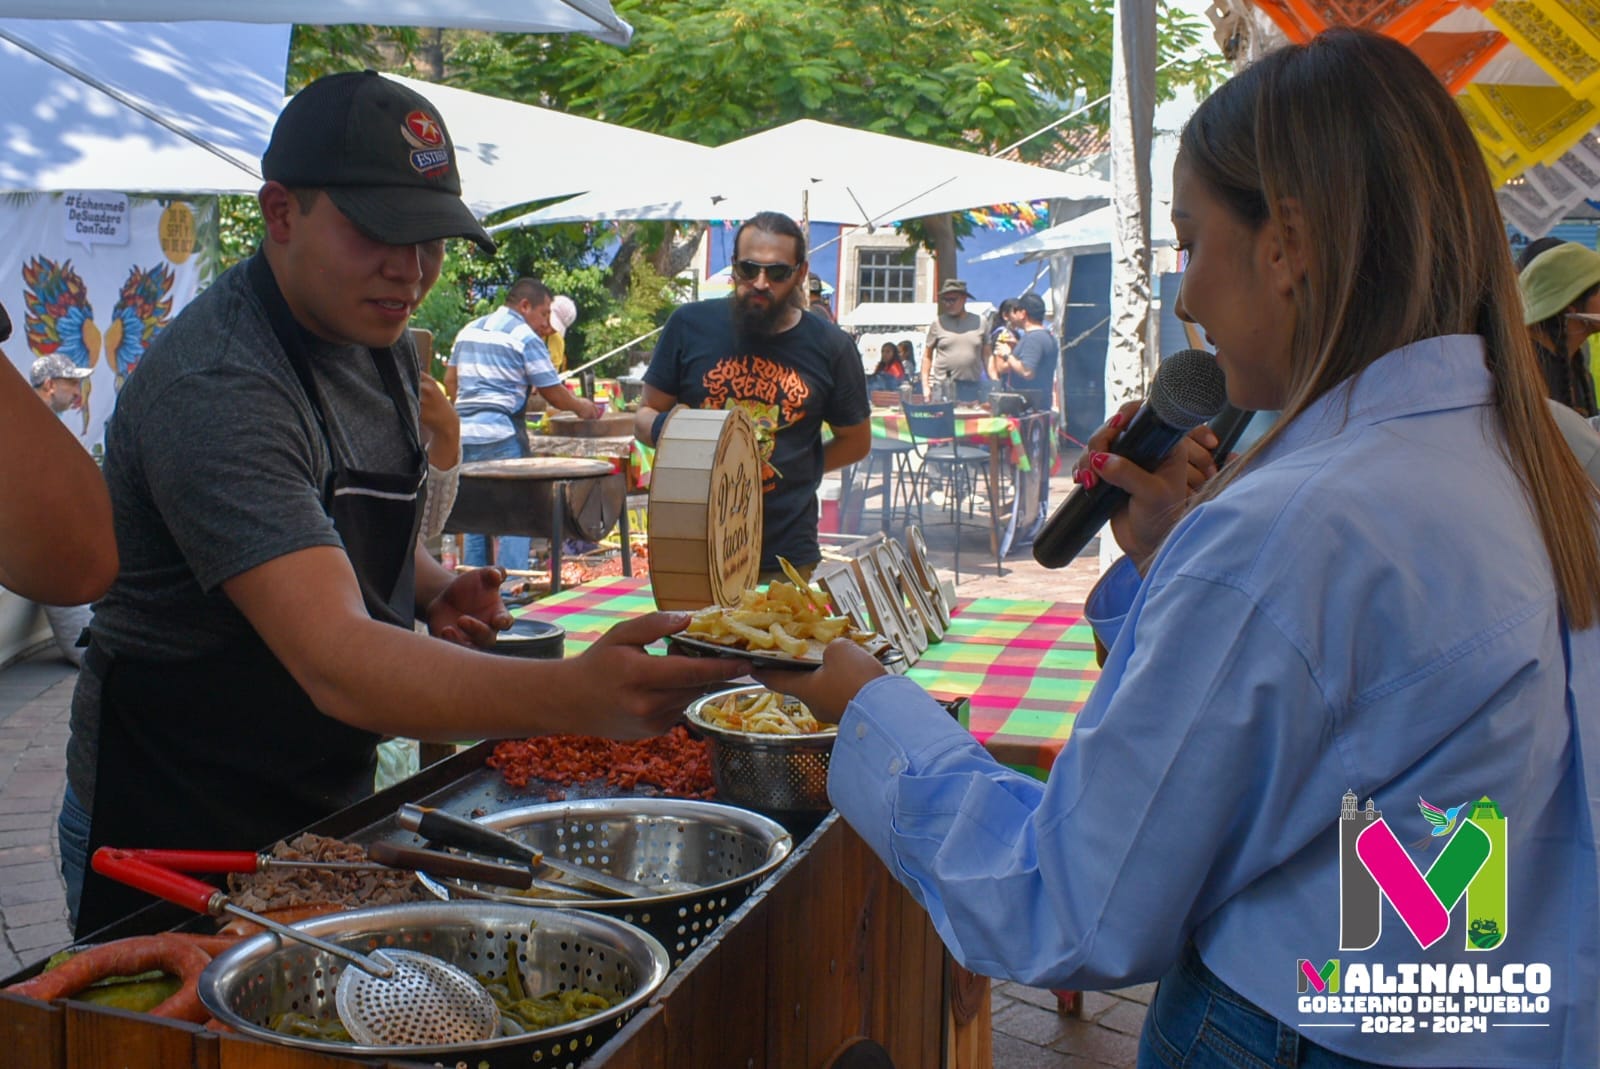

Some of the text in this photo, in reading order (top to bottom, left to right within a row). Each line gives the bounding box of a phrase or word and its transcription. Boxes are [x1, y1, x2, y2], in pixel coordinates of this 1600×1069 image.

[708, 356, 809, 404] SON ROMPE
[731, 375, 778, 404] PERA
